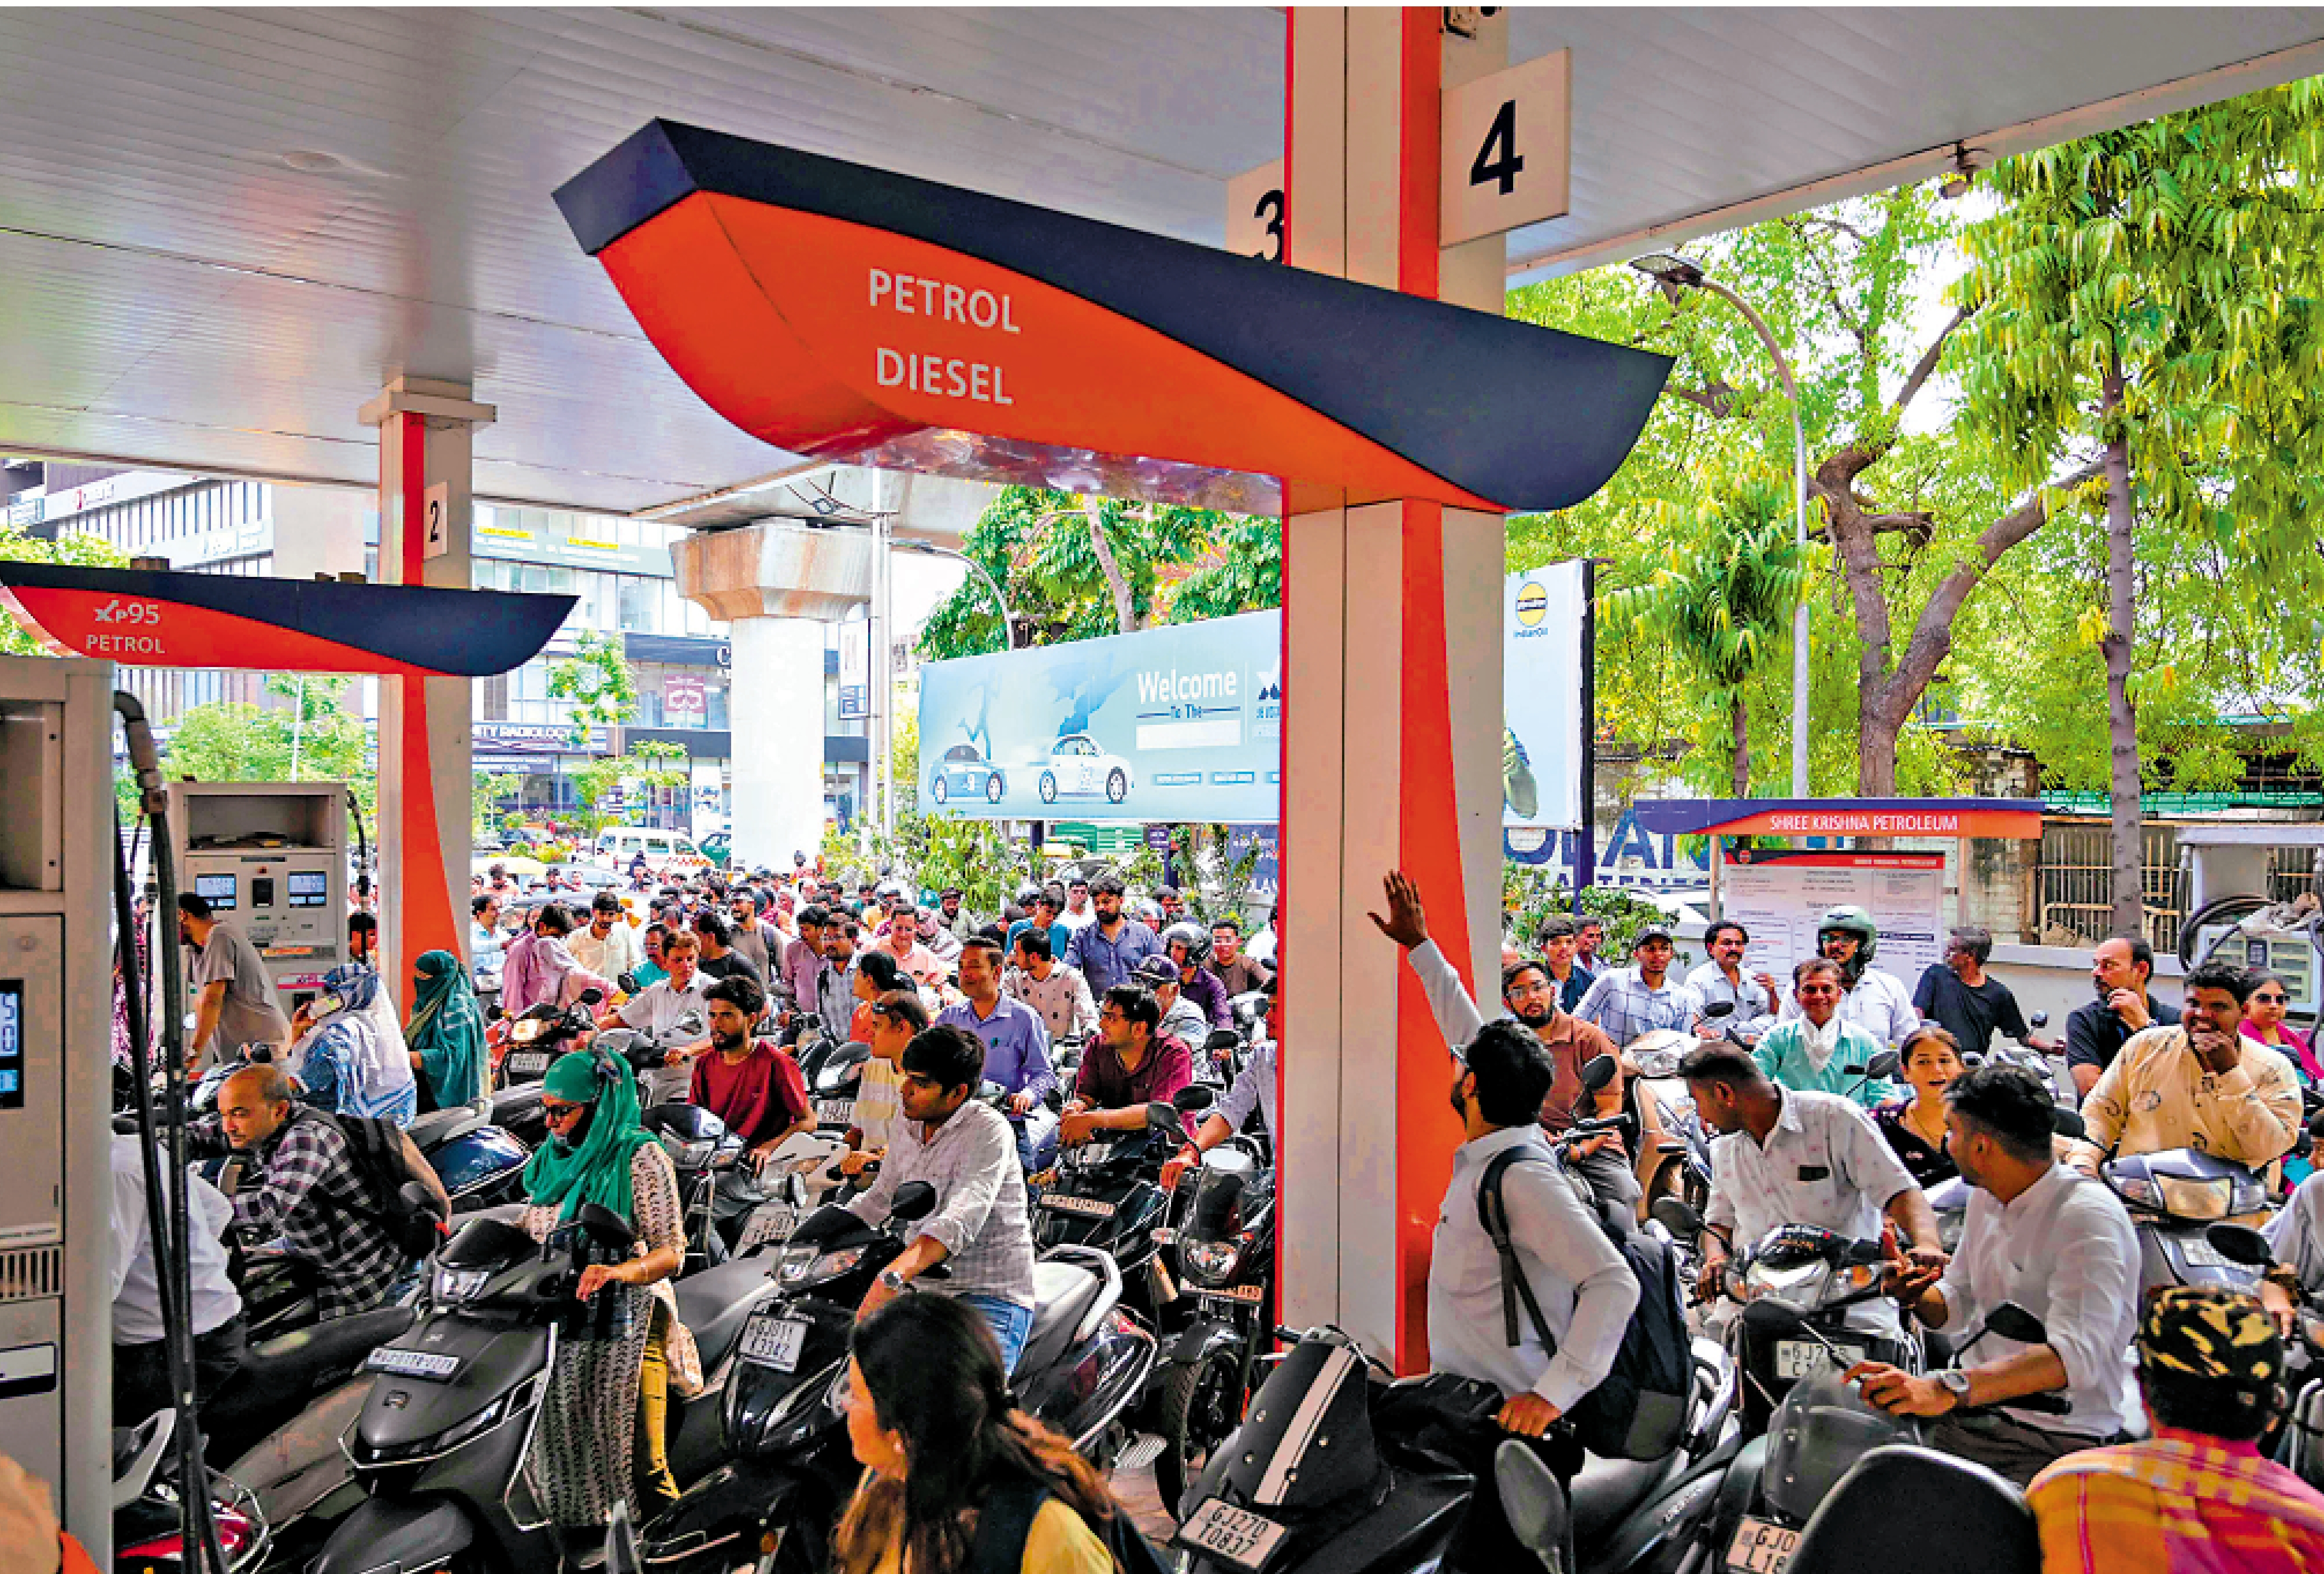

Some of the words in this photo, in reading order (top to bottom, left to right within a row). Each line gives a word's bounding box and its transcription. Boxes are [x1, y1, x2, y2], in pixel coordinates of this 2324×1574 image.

[1469, 99, 1523, 195] 4
[870, 268, 1020, 332] PETROL
[877, 347, 1013, 404] DIESEL
[429, 500, 440, 542] 2
[86, 634, 165, 654] PETROL
[1136, 669, 1236, 705] Welcome
[1769, 815, 1807, 830] SHREE
[1813, 815, 1869, 830] KRISHNA
[1873, 815, 1958, 830] PETROLEUM
